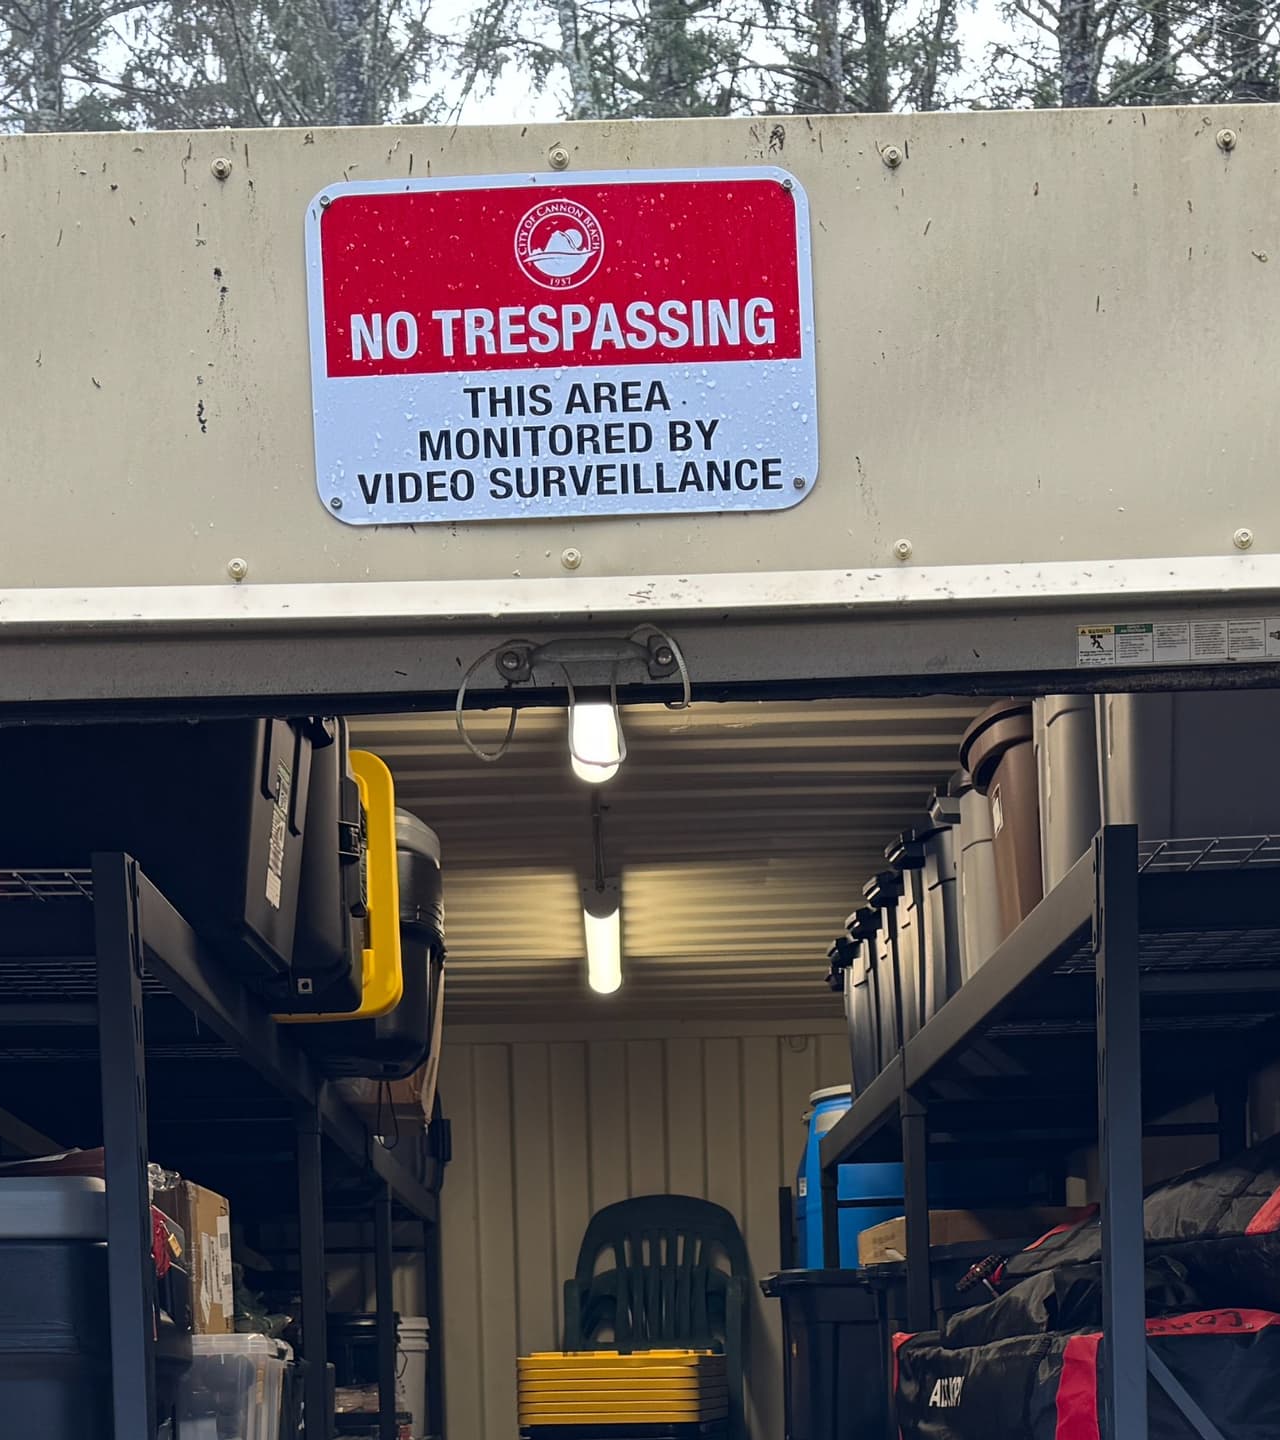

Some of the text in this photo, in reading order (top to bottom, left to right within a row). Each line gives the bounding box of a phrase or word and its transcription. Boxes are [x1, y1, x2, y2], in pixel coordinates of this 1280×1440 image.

[518, 203, 600, 256] CITY OF CANNON BEACH
[549, 277, 572, 287] 1957
[350, 297, 776, 361] NO TRESPASSING
[463, 380, 671, 418] THIS AREA
[419, 419, 719, 461] MONITORED BY
[357, 458, 783, 505] VIDEO SURVEILLANCE
